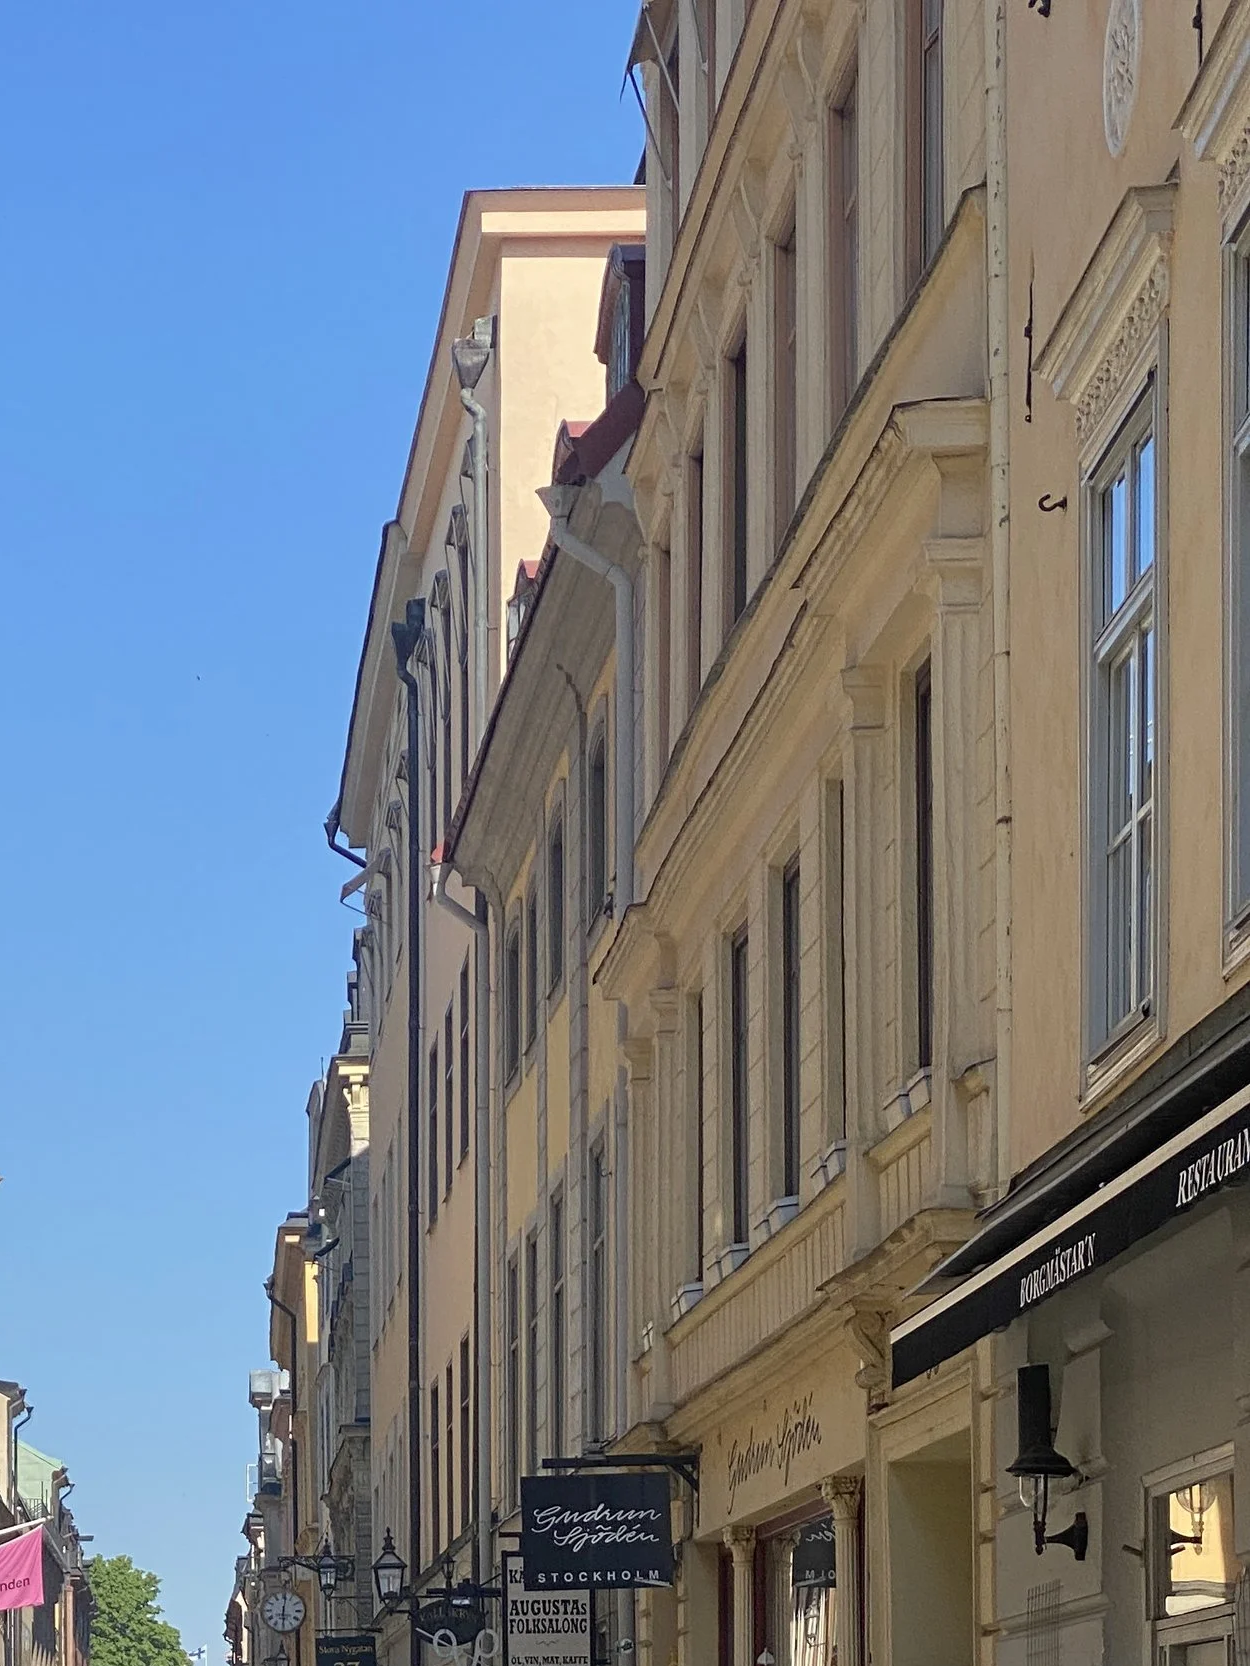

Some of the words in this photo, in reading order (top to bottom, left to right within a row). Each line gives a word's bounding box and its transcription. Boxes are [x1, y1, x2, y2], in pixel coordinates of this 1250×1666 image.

[531, 1503, 662, 1533] Gudrun
[537, 1570, 660, 1584] STOCKHOLM
[509, 1618, 588, 1635] FOLKSALONG
